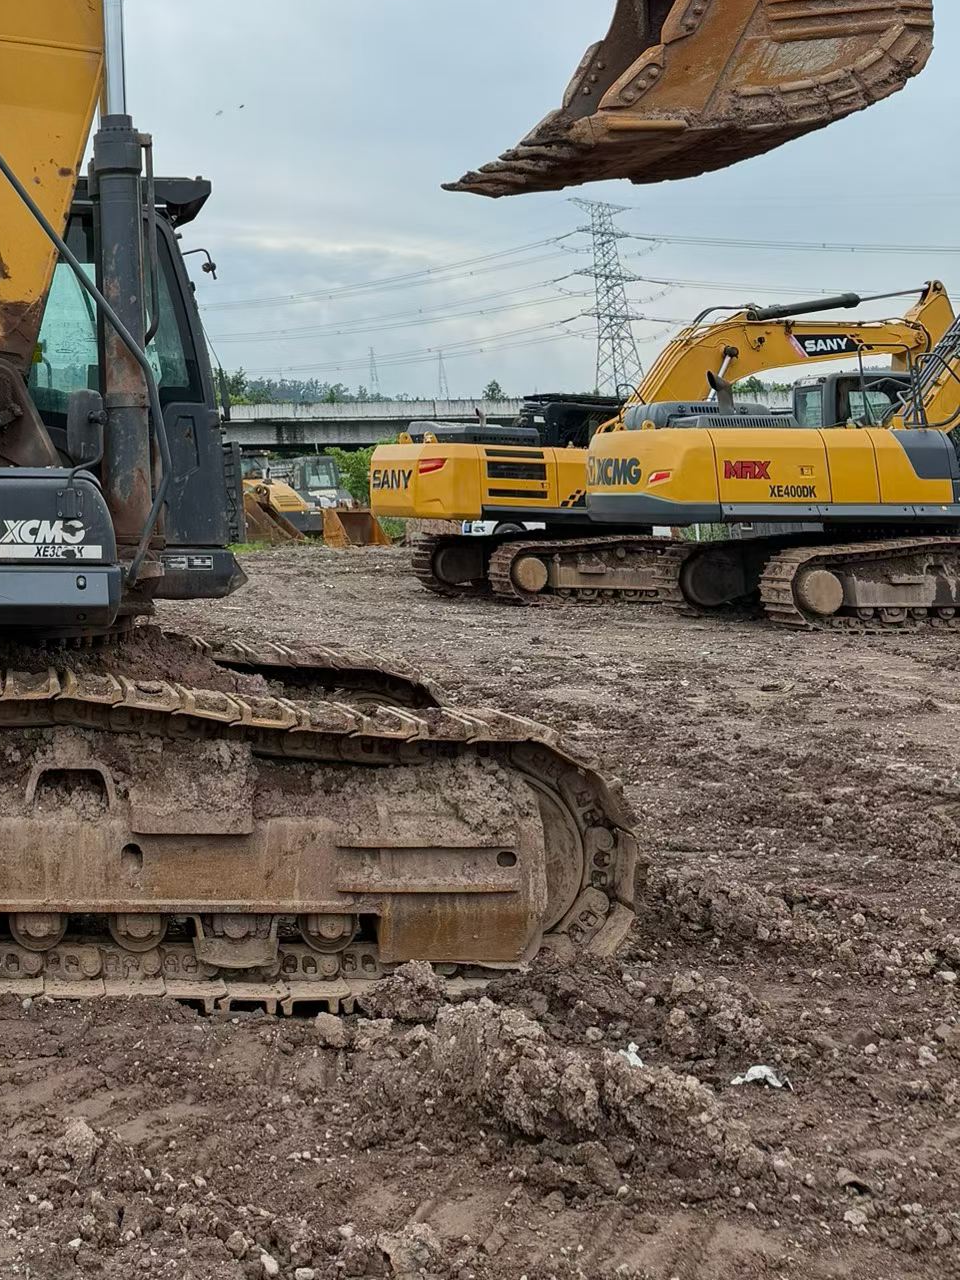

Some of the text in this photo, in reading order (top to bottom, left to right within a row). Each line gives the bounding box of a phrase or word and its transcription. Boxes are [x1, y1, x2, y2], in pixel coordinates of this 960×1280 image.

[804, 337, 847, 352] SANY
[373, 469, 412, 489] SANY
[596, 457, 641, 486] XCMG
[724, 460, 771, 479] MAX
[769, 485, 817, 498] XE400DK
